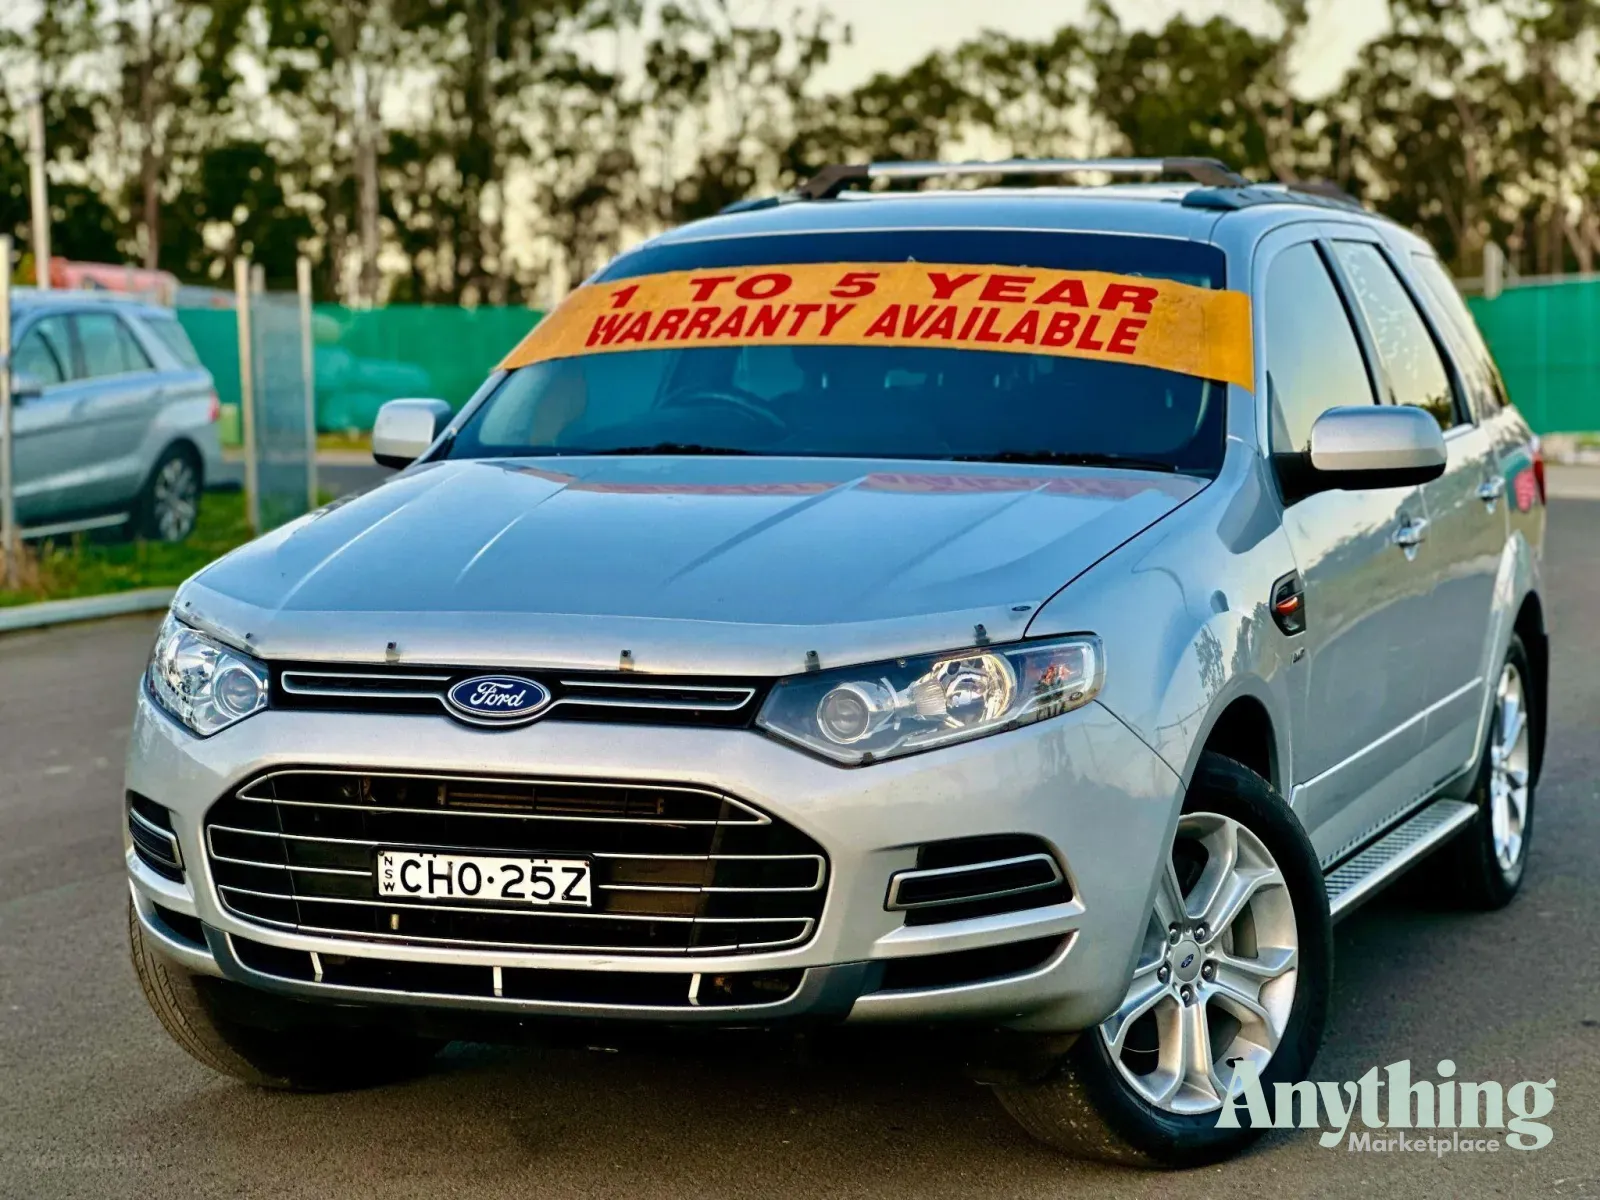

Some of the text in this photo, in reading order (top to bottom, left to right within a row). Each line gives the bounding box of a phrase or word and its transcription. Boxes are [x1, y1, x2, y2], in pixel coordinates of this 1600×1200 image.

[609, 272, 1159, 315] 1 TO 5 YEAR
[585, 303, 1146, 355] WARRANTY AVAILABLE
[470, 681, 527, 707] Ford
